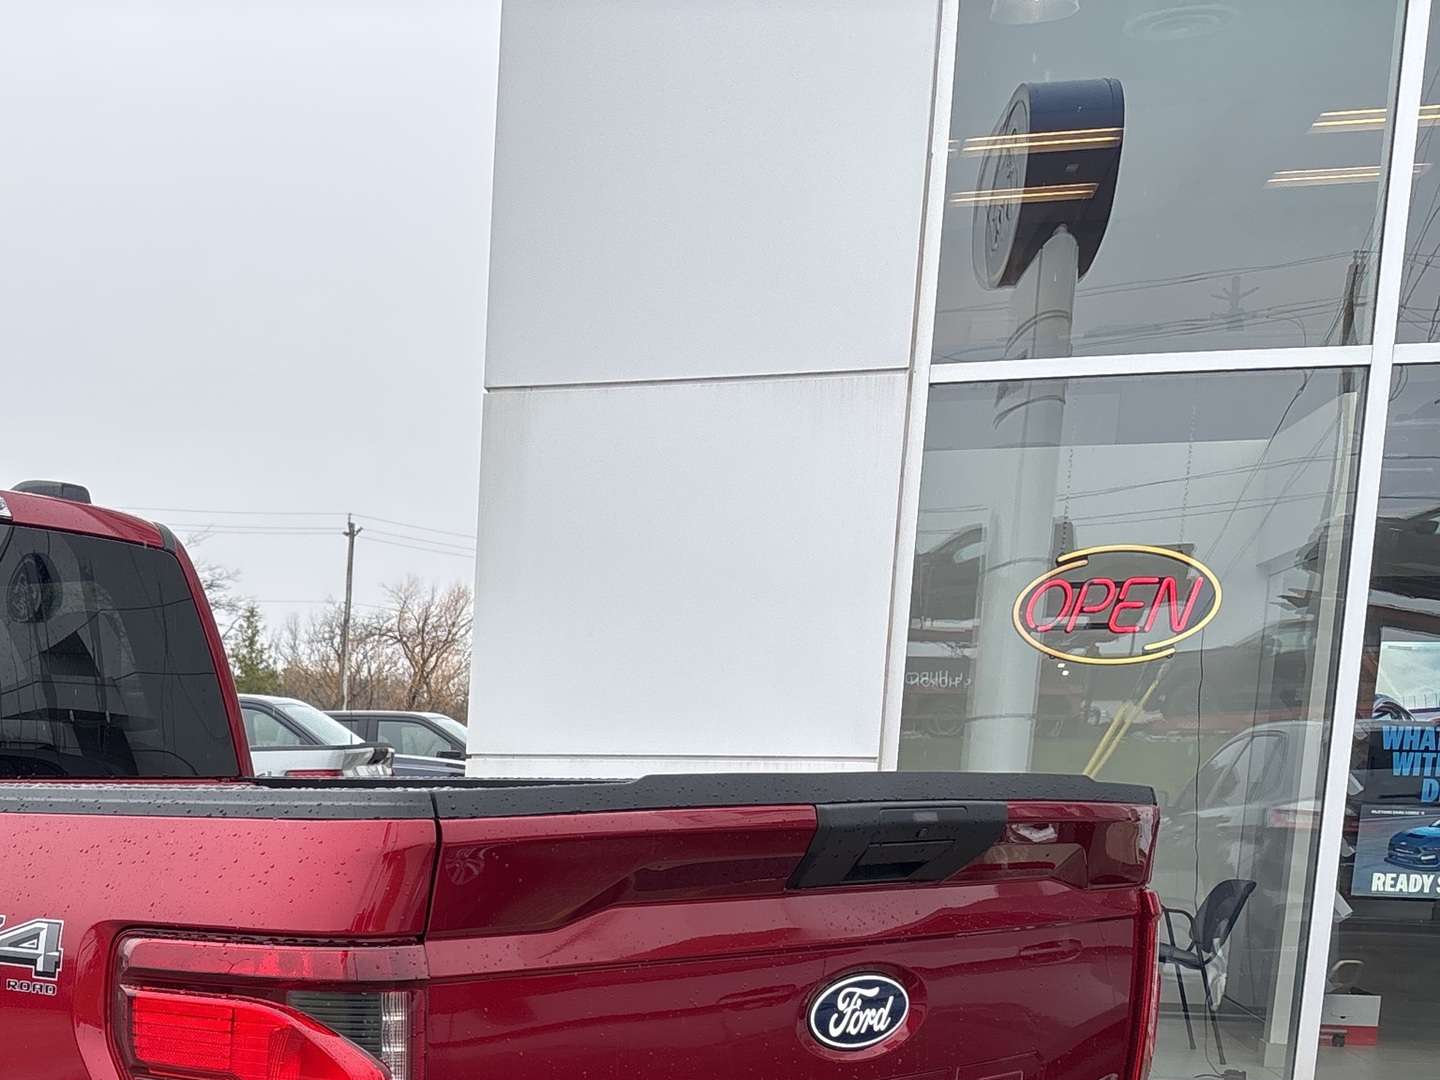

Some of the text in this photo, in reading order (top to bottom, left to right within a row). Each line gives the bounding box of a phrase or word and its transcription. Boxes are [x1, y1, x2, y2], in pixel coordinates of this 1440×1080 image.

[1025, 576, 1204, 633] OPEN
[1421, 778, 1440, 803] D
[1371, 872, 1435, 893] READY
[6, 979, 57, 996] ROAD
[829, 987, 894, 1037] Ford
